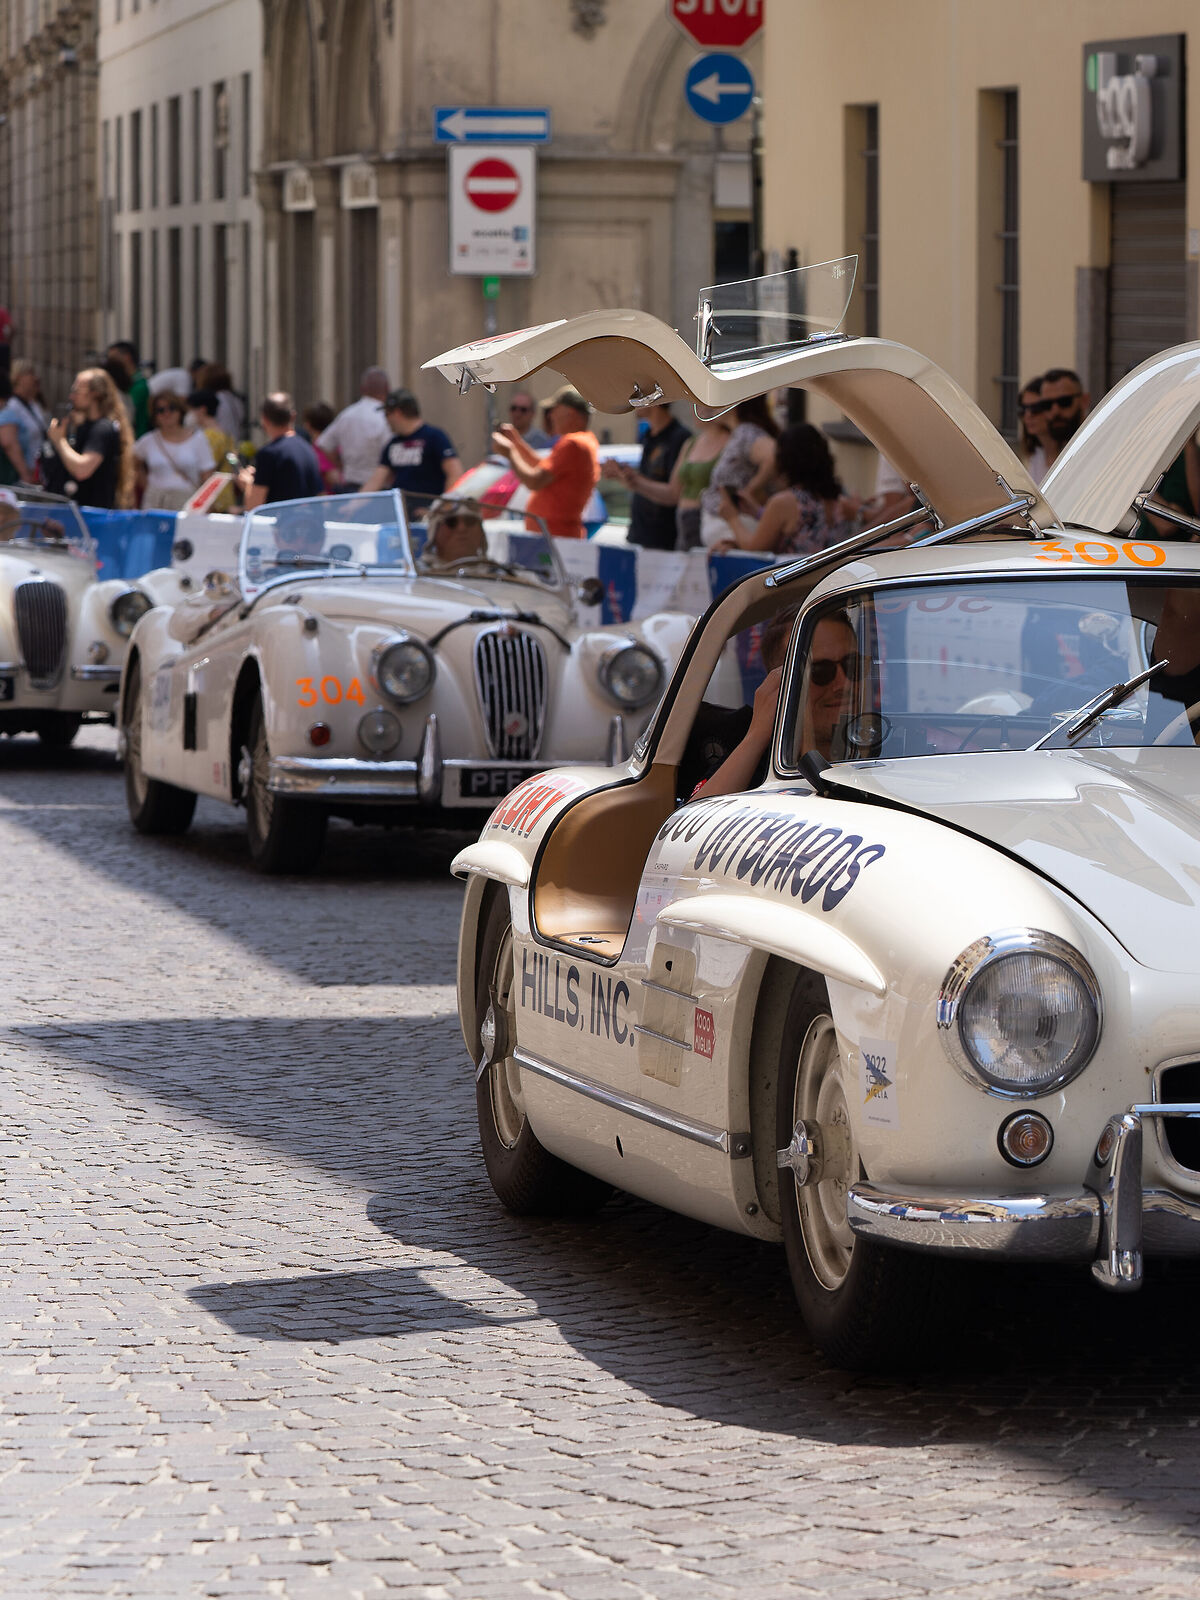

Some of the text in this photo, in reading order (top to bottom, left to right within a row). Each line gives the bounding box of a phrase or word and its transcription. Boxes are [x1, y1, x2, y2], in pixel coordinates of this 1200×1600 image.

[1029, 541, 1166, 567] 300
[296, 675, 366, 707] 304
[693, 806, 886, 912] OUTBOARDS
[521, 947, 635, 1048] HILLS, INC.
[696, 1012, 711, 1032] 1000
[866, 1053, 887, 1074] 2022
